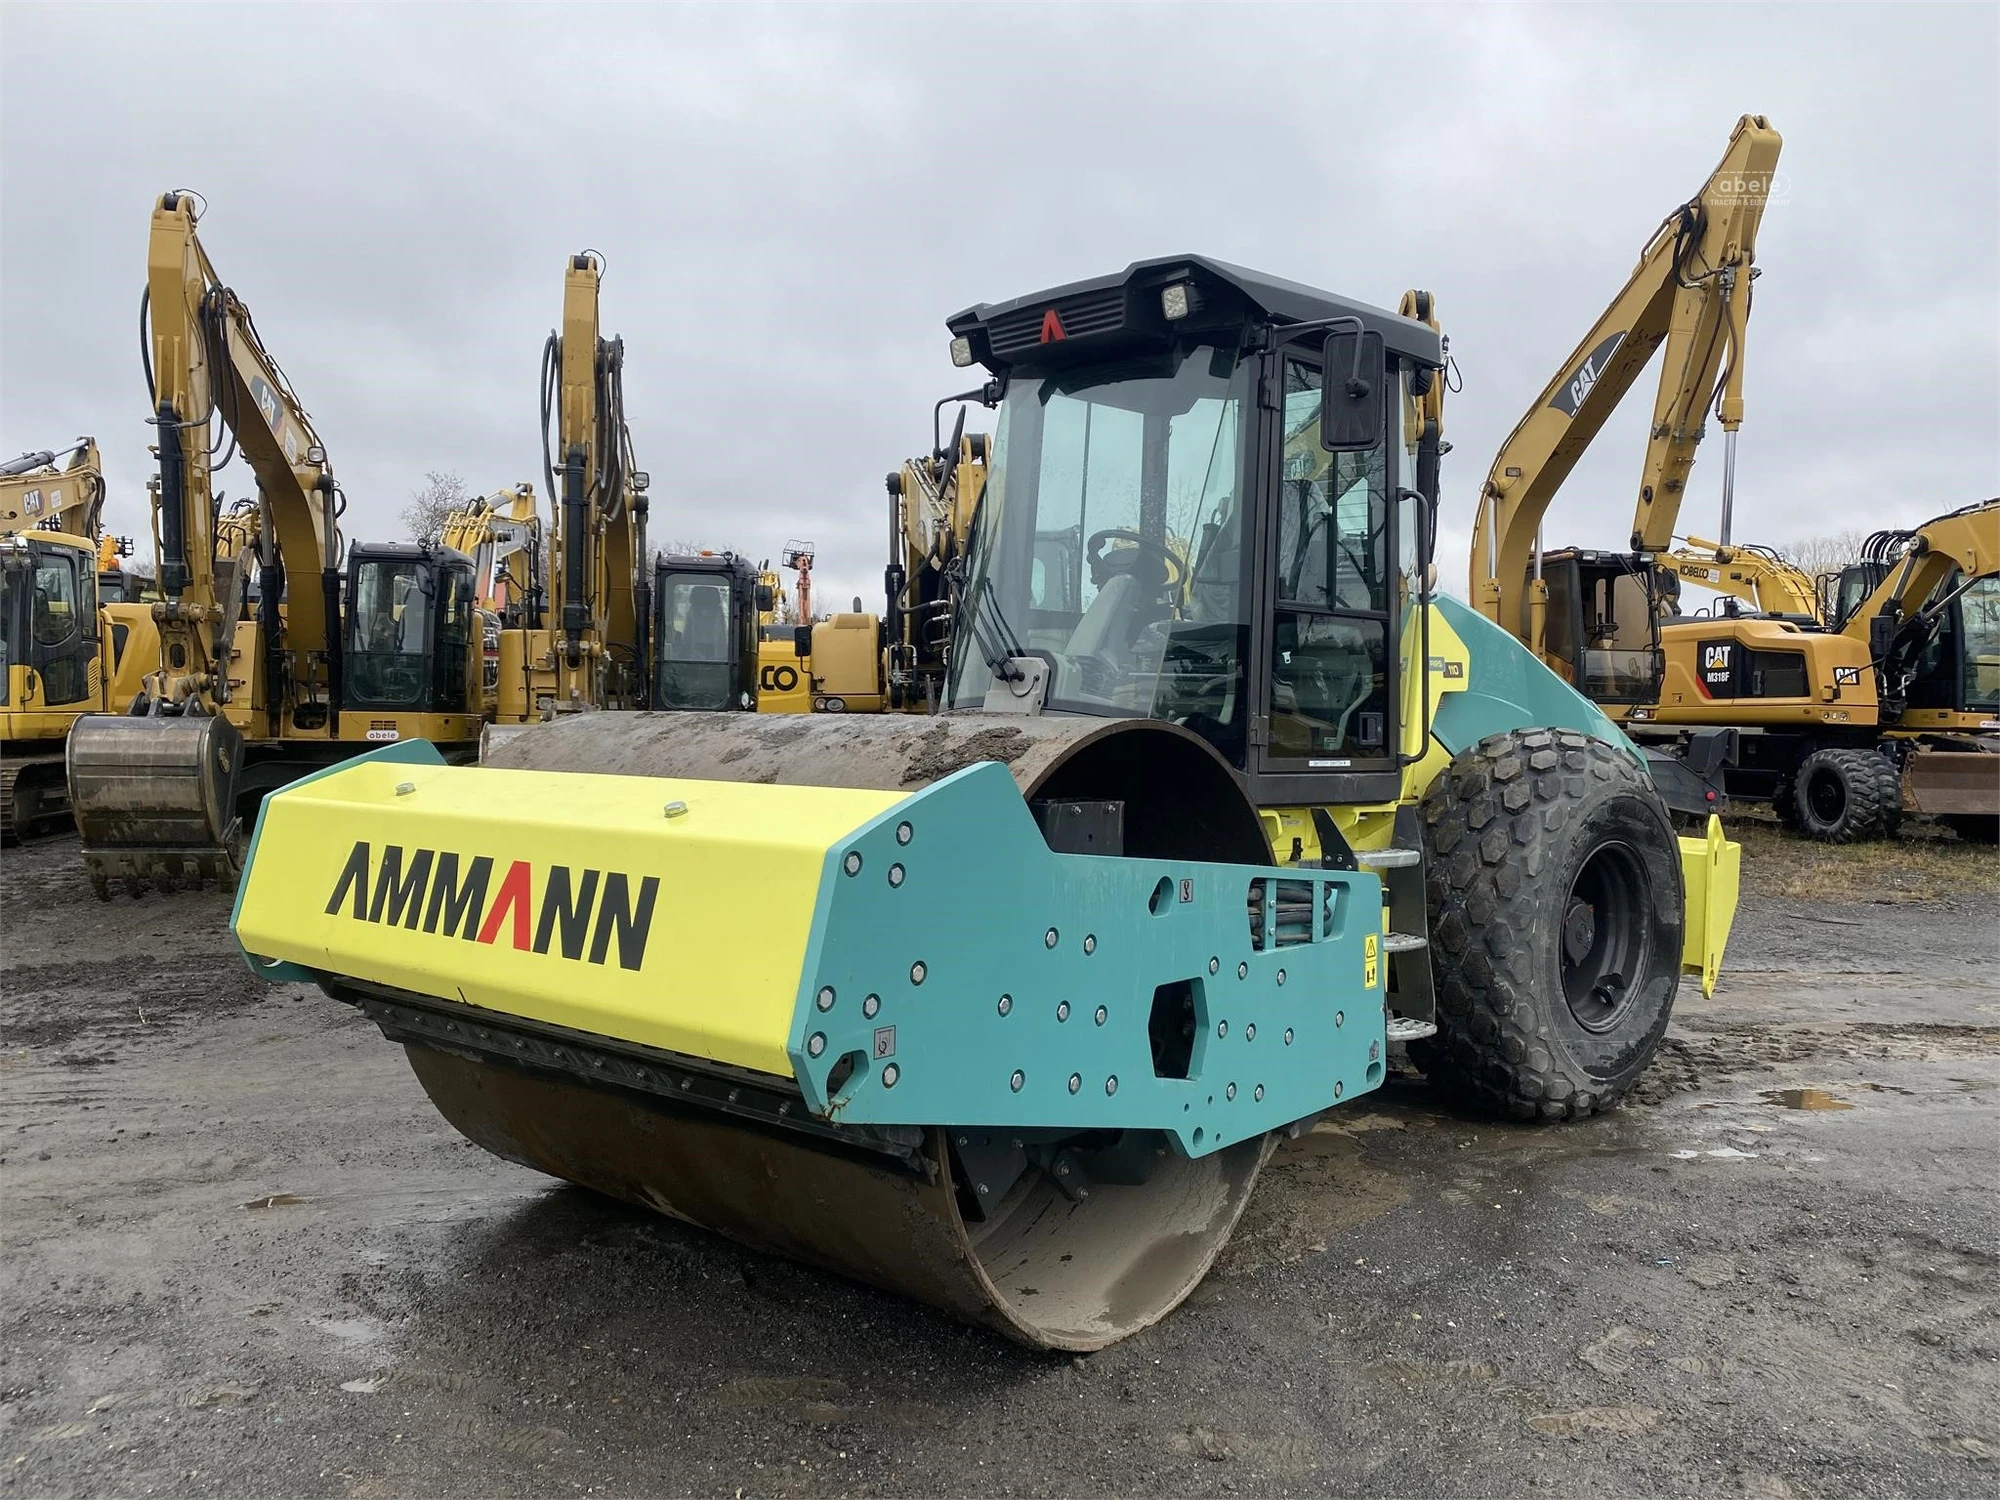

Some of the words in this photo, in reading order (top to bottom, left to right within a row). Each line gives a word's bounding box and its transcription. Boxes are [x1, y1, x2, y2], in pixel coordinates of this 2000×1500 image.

[1571, 356, 1597, 407] CAT
[261, 384, 276, 426] CAT
[23, 489, 40, 515] CAT
[1680, 564, 1709, 579] KOBELCO
[1705, 646, 1731, 668] CAT
[758, 665, 798, 691] CO
[1706, 672, 1730, 682] M318F
[1836, 668, 1858, 684] CAT
[369, 731, 396, 739] abele
[324, 841, 661, 972] AMMANN
